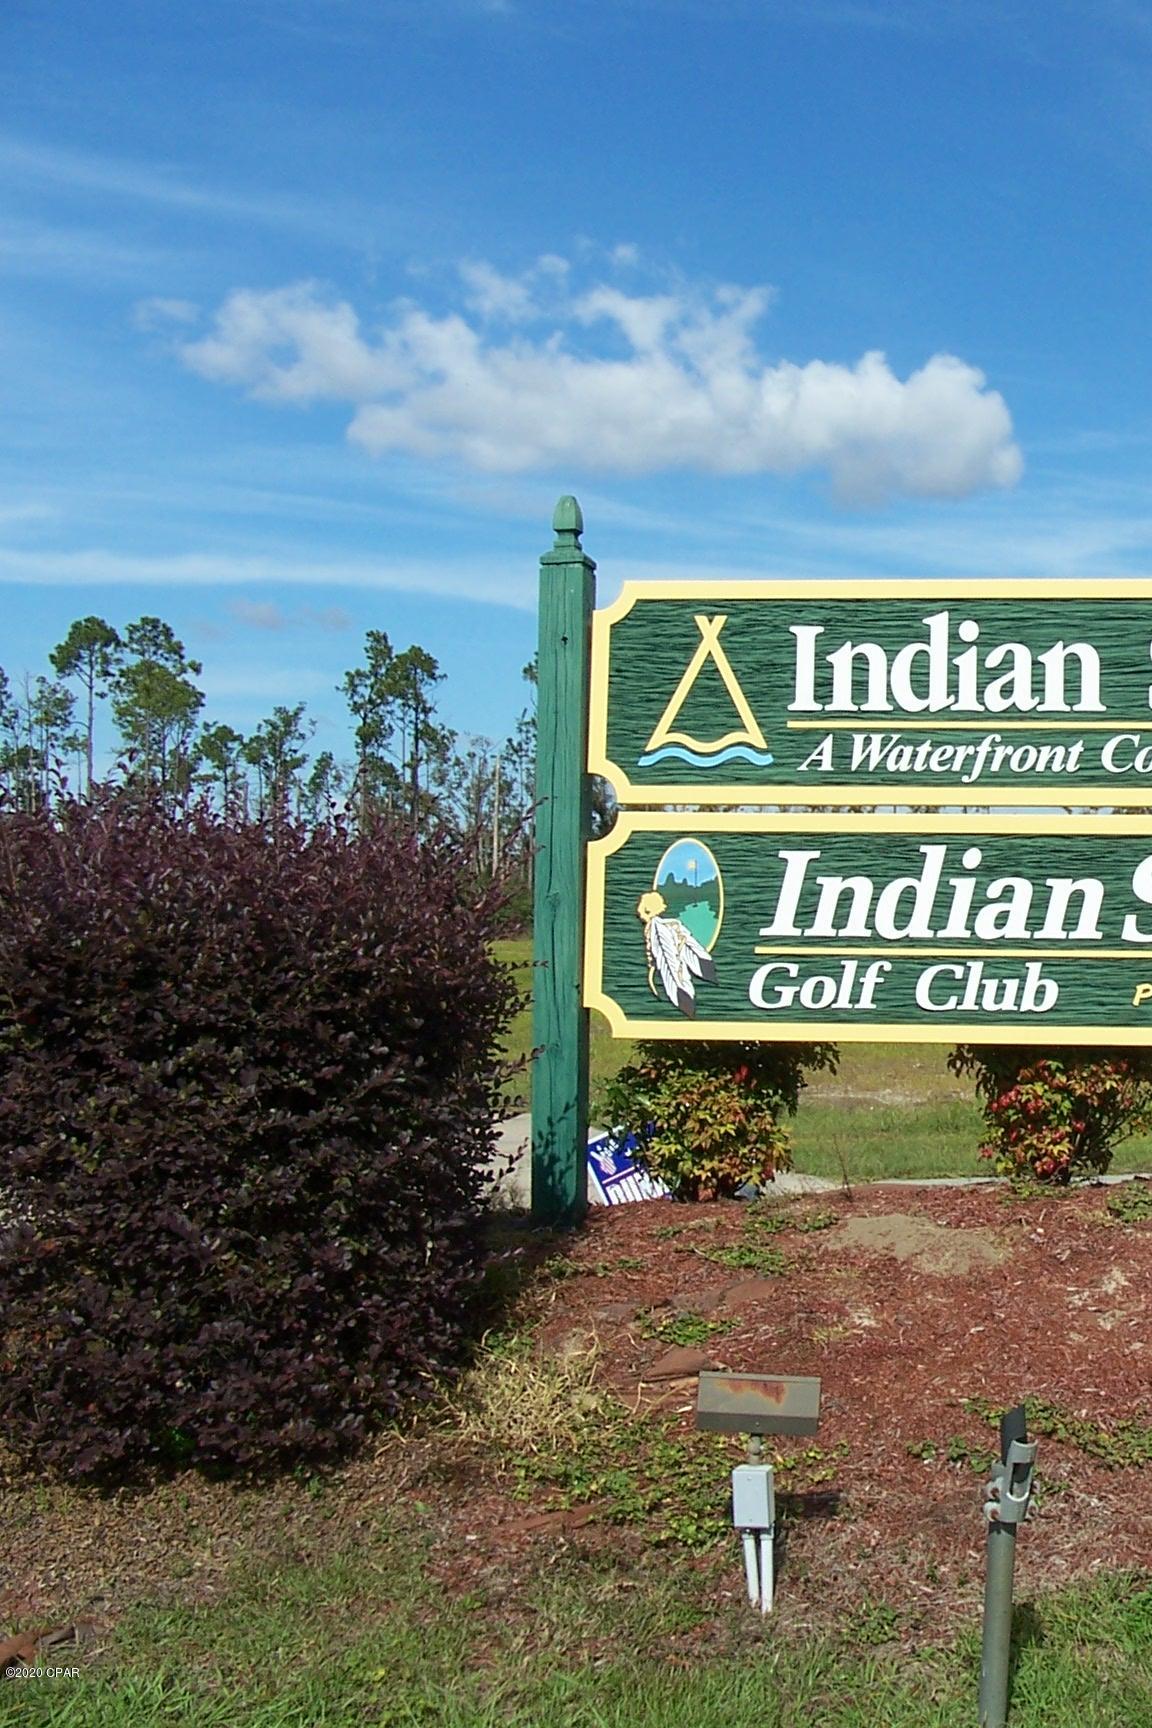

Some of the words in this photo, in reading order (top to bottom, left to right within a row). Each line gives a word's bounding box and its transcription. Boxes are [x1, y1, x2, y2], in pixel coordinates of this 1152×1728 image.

[787, 611, 1107, 714] Indian
[797, 733, 834, 771] A
[851, 733, 1084, 783] Waterfront
[759, 845, 1105, 941] Indian
[748, 961, 893, 1010] Golf
[915, 962, 1060, 1012] Club
